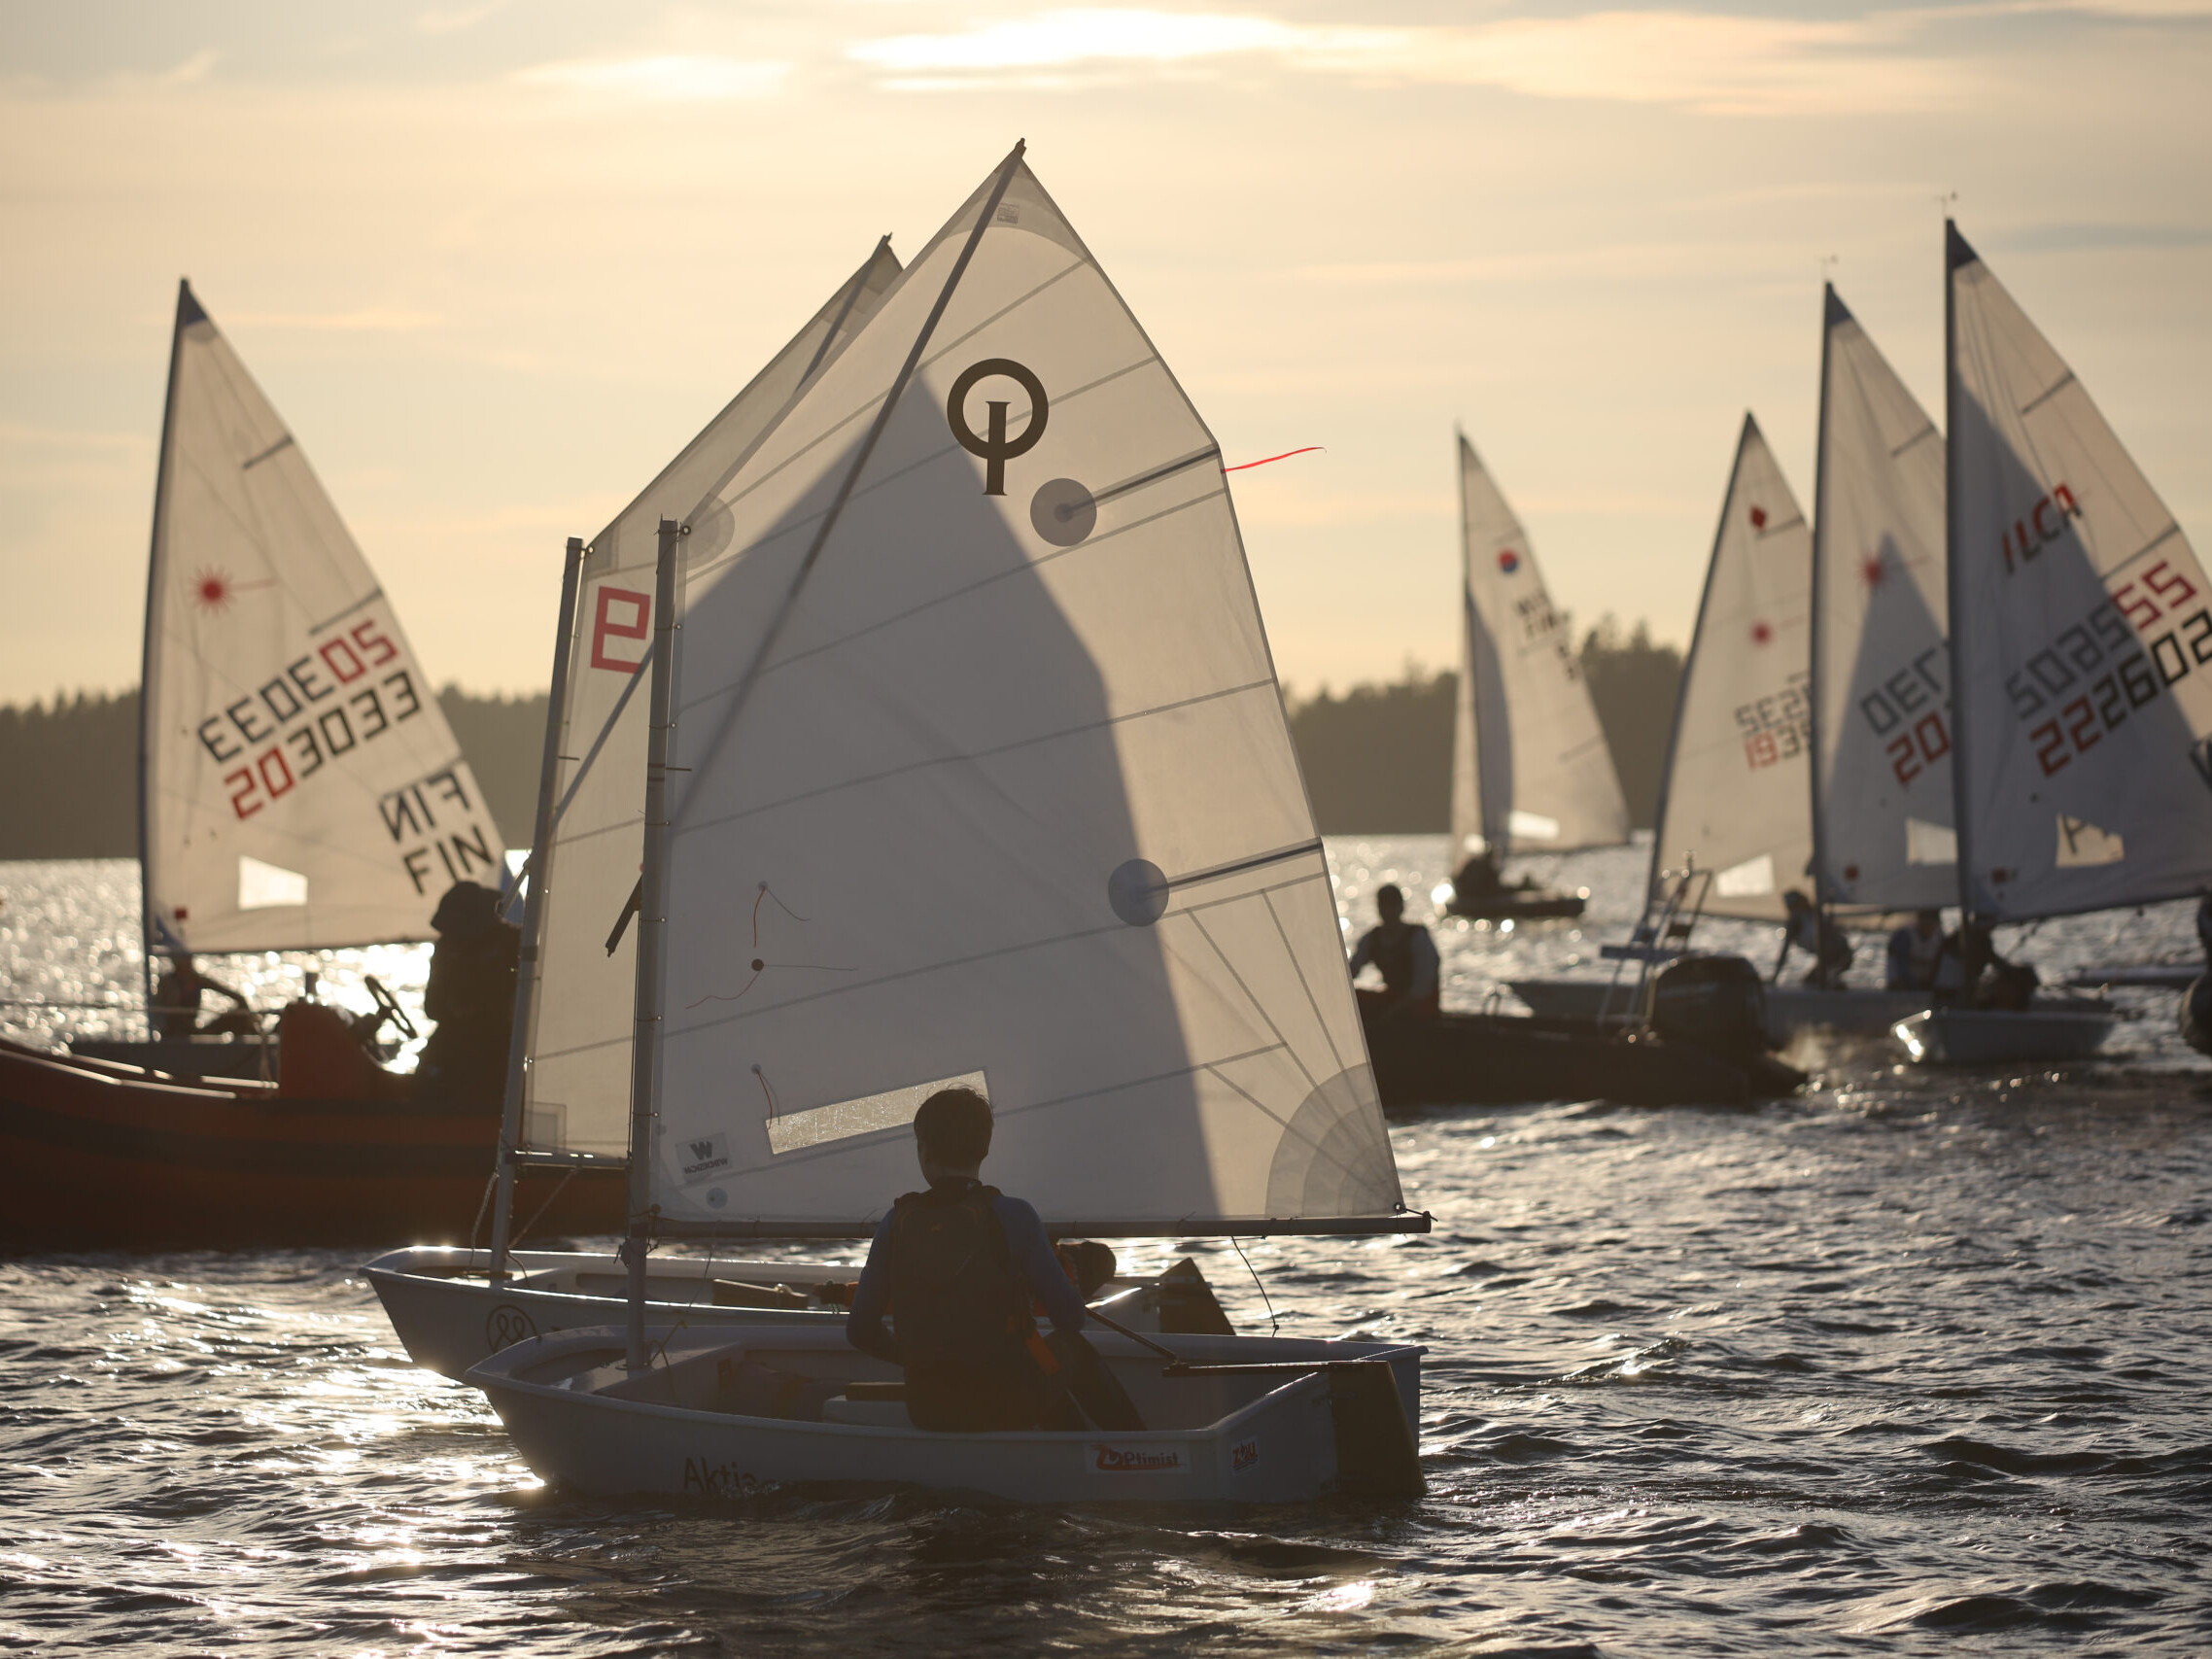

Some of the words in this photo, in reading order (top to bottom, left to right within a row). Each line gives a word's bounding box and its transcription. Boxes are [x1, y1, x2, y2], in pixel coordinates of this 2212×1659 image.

[2000, 482, 2082, 574] ILCA
[223, 670, 422, 821] 203033
[402, 824, 496, 896] FIN
